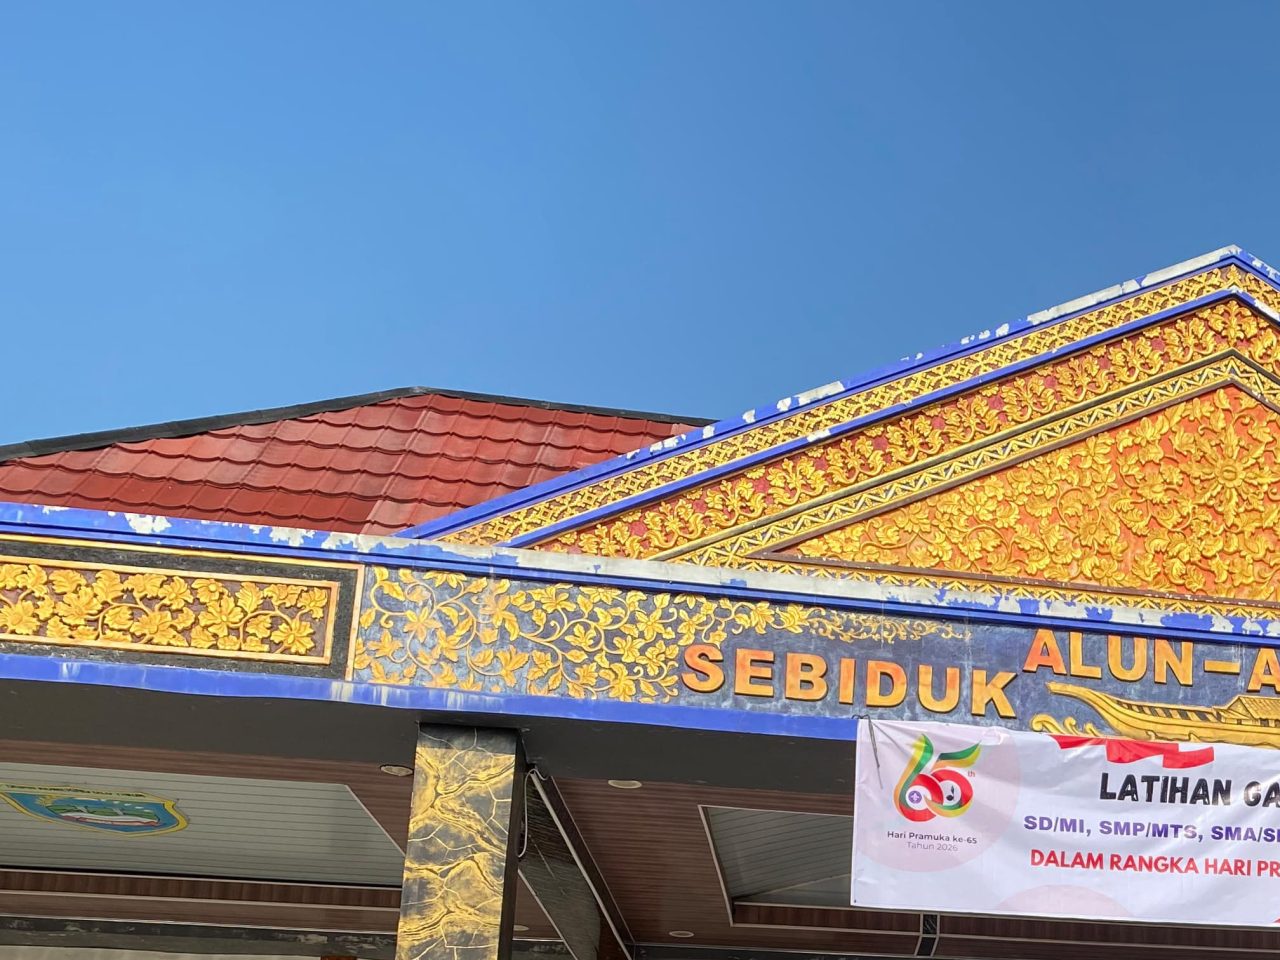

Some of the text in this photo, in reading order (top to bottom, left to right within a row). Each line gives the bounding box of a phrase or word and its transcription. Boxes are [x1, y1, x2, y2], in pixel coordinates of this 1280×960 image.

[680, 644, 1018, 719] SEBIDUK
[1100, 772, 1232, 806] LATIHAN
[887, 830, 978, 845] Hari Pramuka ke-65
[1024, 815, 1091, 837] SD/MI,
[1099, 820, 1204, 843] SMP/MTS,
[906, 841, 959, 852] Tahun 2026
[1030, 849, 1105, 870] DALAM
[1109, 853, 1199, 875] RANGKA
[1204, 858, 1251, 877] HARI
